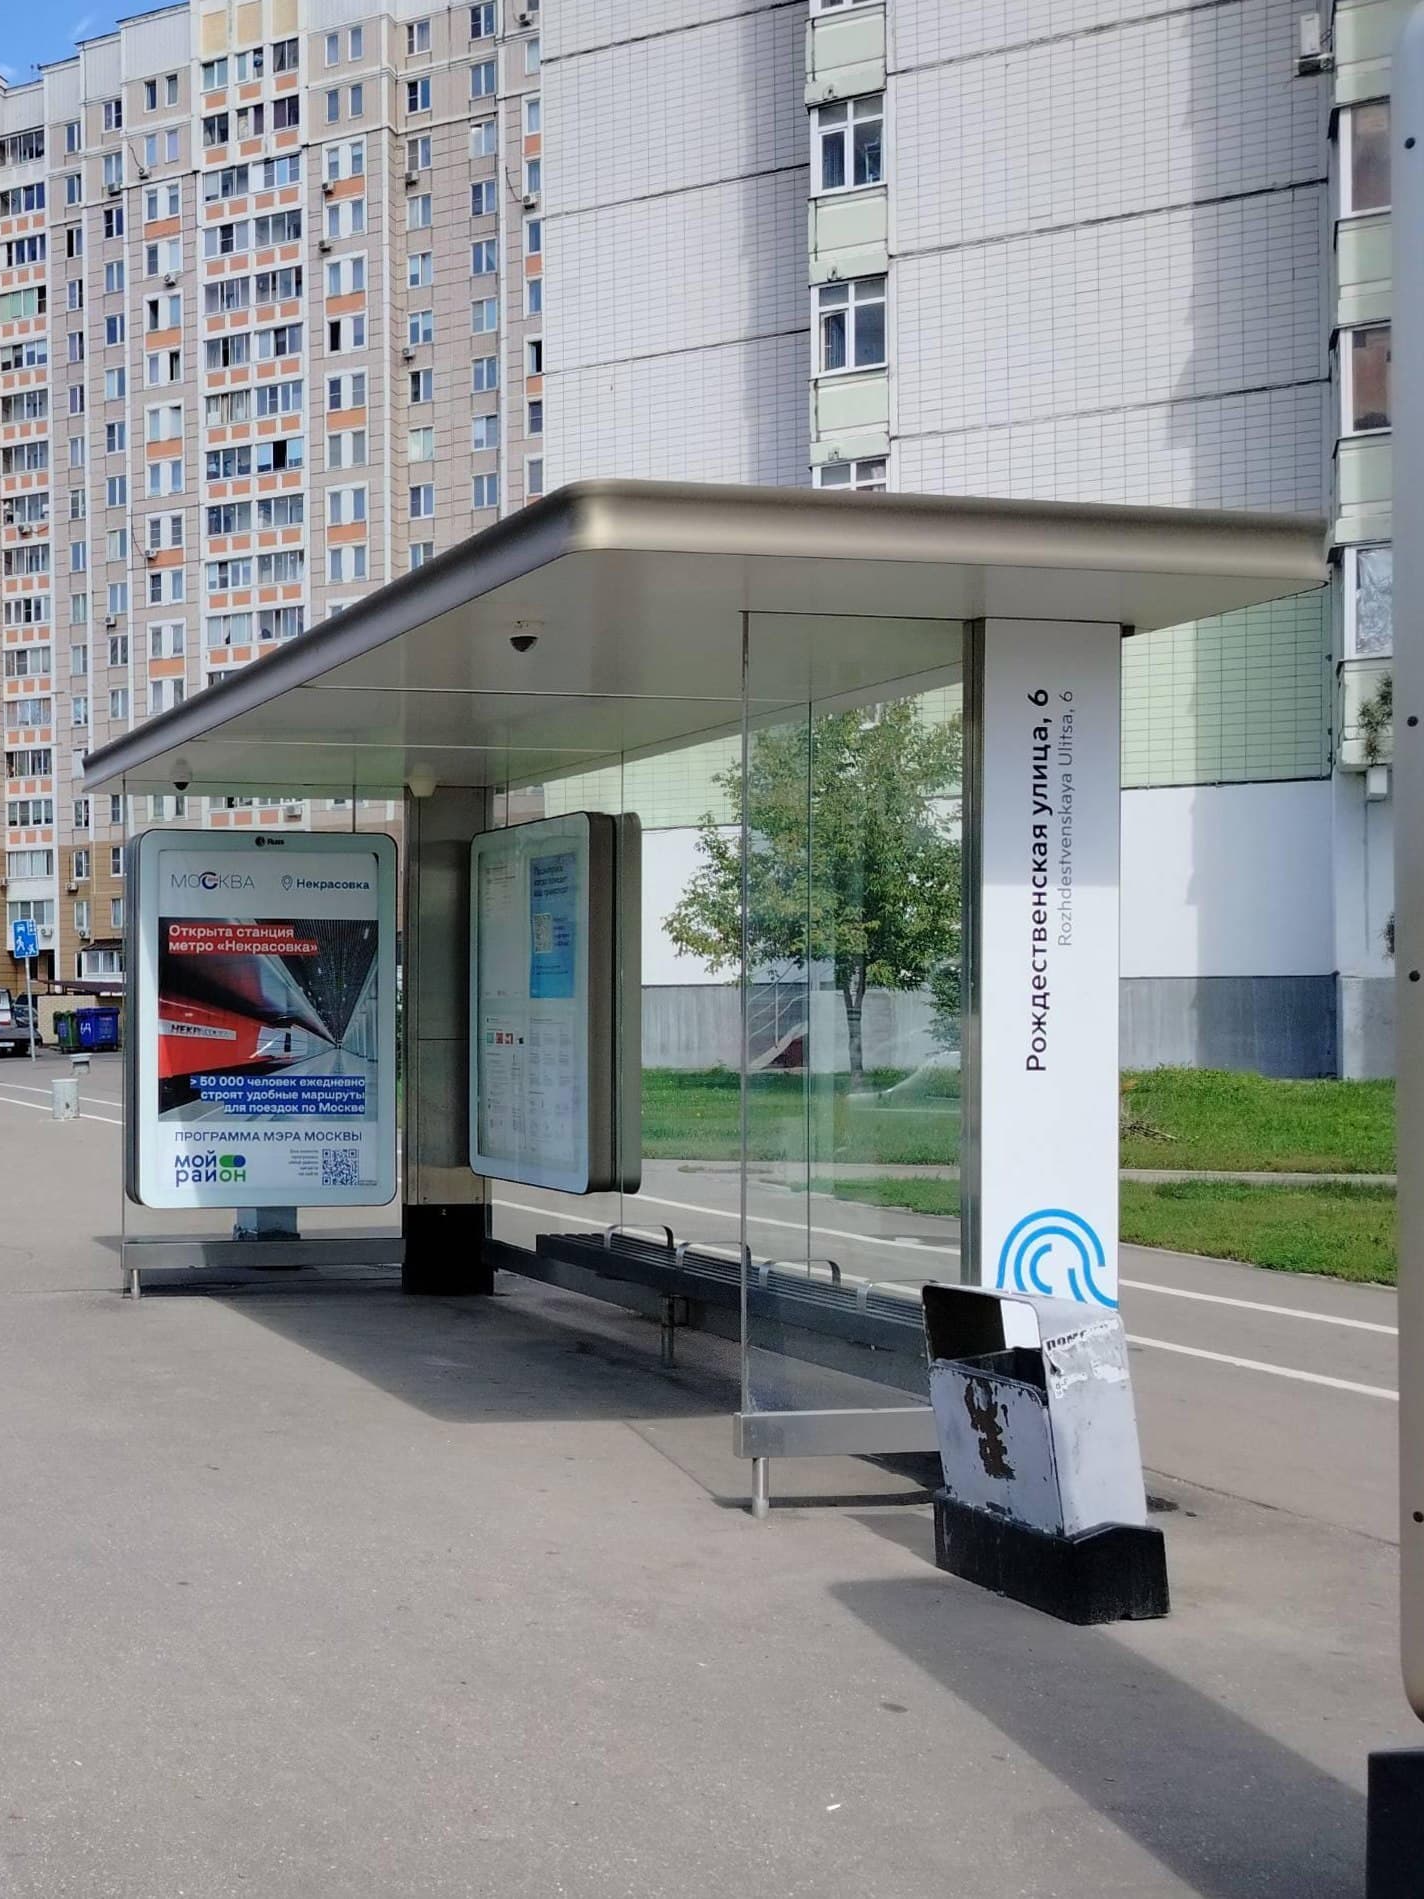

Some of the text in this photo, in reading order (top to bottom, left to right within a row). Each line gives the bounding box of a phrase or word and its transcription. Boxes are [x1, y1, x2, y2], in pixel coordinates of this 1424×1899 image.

[1057, 690, 1076, 946] Rozhdestvenskaya Ulitsa, 6
[170, 871, 255, 890] МОСКВА
[296, 878, 371, 891] Некрасовка
[1026, 688, 1053, 1071] Рождественская улица, 6
[168, 924, 295, 938] Открыта станция
[168, 940, 318, 954] метро «Некрасовка»
[200, 1076, 216, 1087] 50
[219, 1076, 244, 1087] 000
[247, 1077, 297, 1087] человек
[299, 1078, 365, 1089] ежедневно
[200, 1089, 365, 1101] строят удобные маршруты
[224, 1103, 365, 1114] для поездок по Москве
[175, 1131, 363, 1142] ПРОГРАММА МЭРА МОСКВЫ
[174, 1150, 217, 1168] мой
